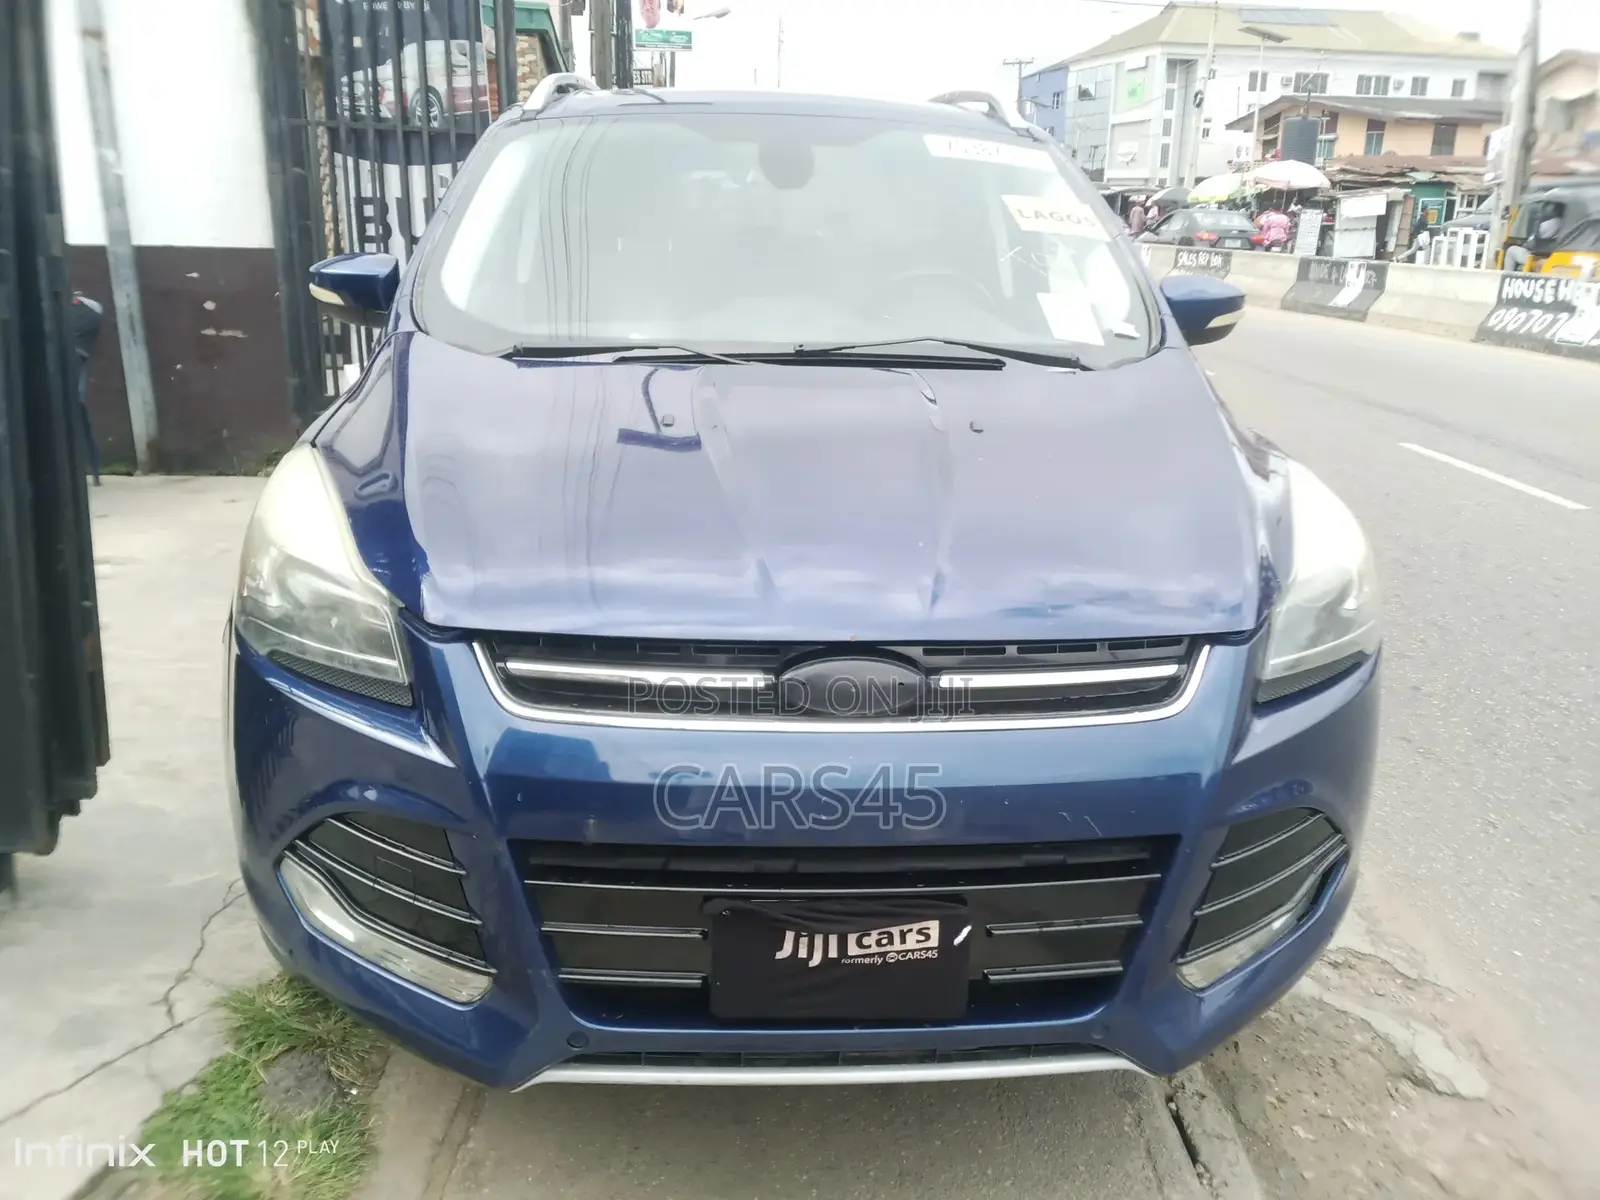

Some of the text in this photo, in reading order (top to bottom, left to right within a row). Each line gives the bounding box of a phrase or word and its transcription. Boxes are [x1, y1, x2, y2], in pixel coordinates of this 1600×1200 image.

[1016, 208, 1096, 228] LAGOS
[1502, 277, 1557, 304] HOUSE
[1487, 307, 1570, 339] 090707
[855, 926, 932, 950] cars
[841, 950, 938, 965] formerly CARS45
